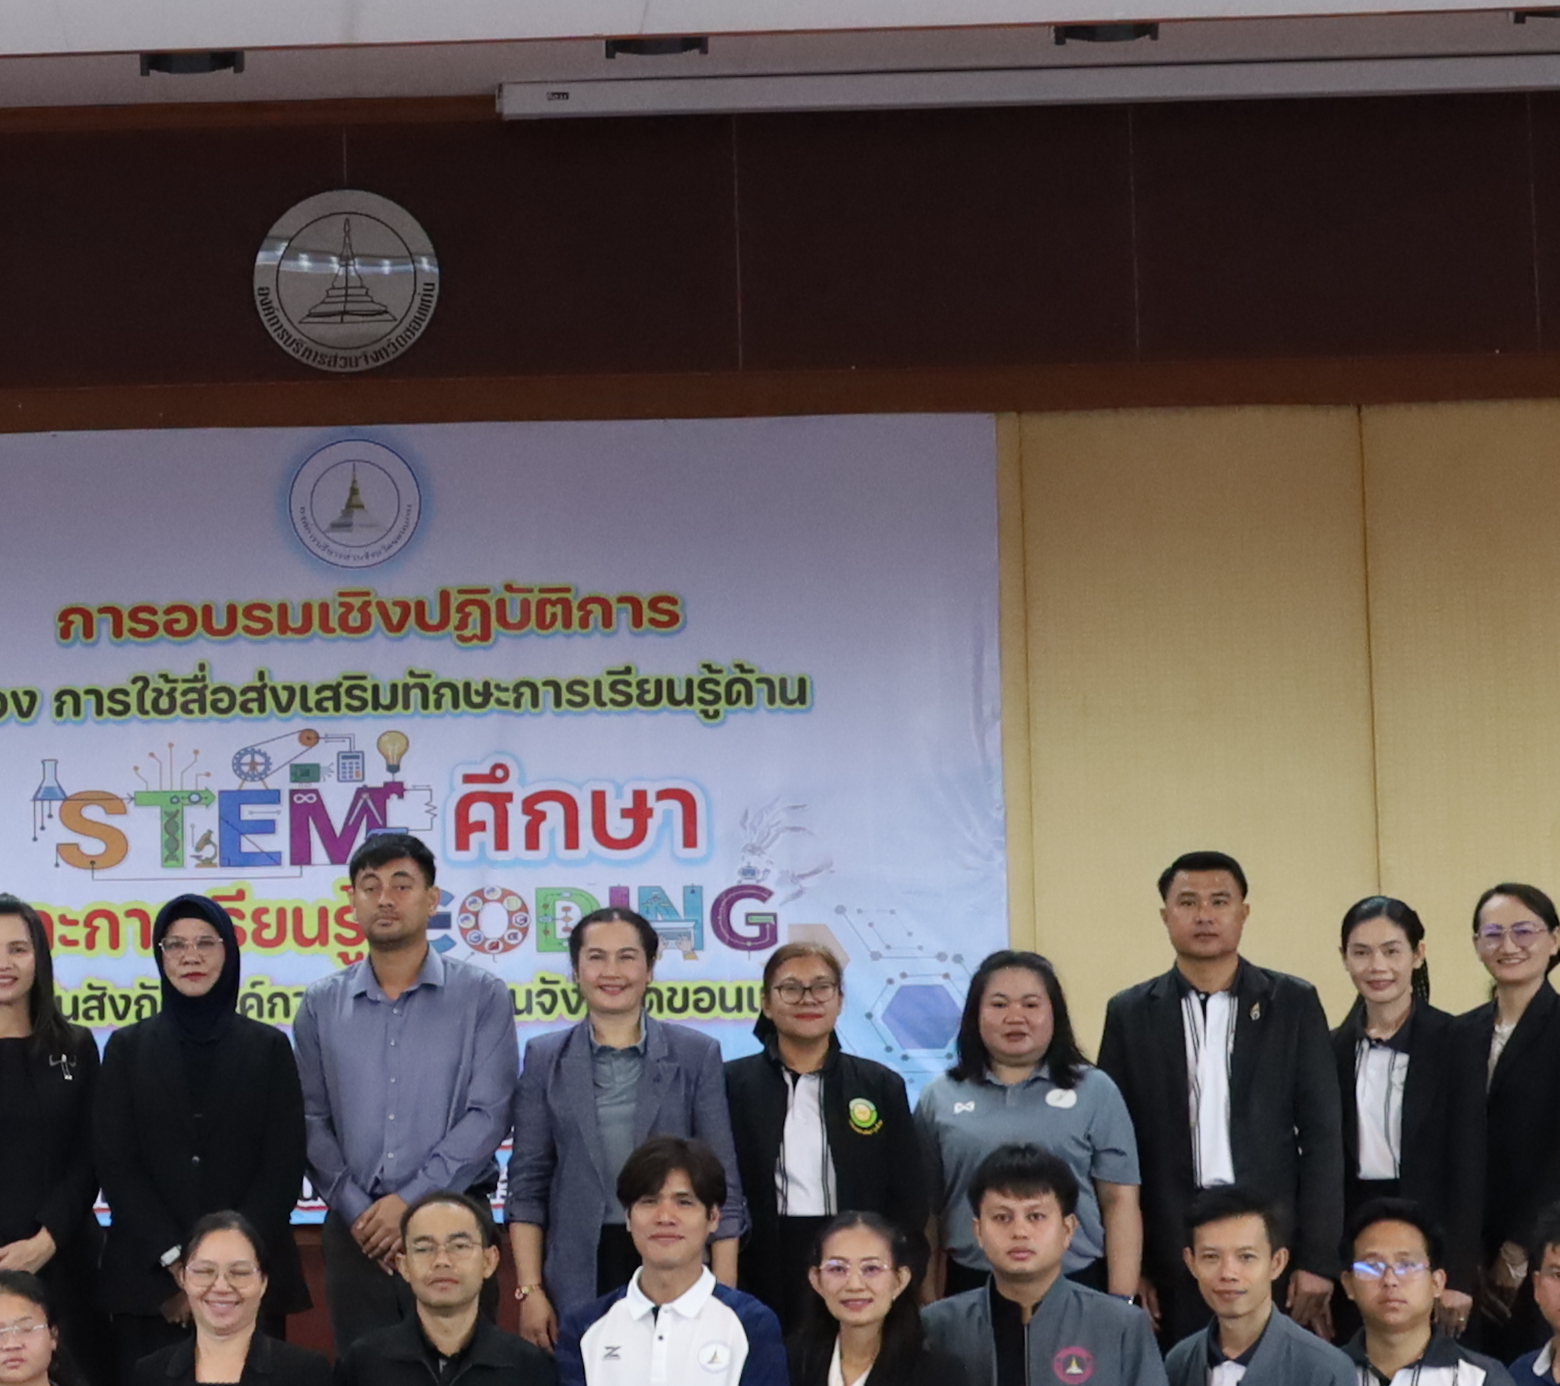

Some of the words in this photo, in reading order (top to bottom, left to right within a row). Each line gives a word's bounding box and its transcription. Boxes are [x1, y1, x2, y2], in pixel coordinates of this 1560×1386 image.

[57, 583, 681, 643] การอบรมเชิงปฏิบัติการ
[54, 662, 807, 720] การใช้สื่อส่งเสริมทักษะการเรียนรู้ด้าน
[56, 781, 406, 870] STEM
[453, 762, 699, 852] ศึกษา
